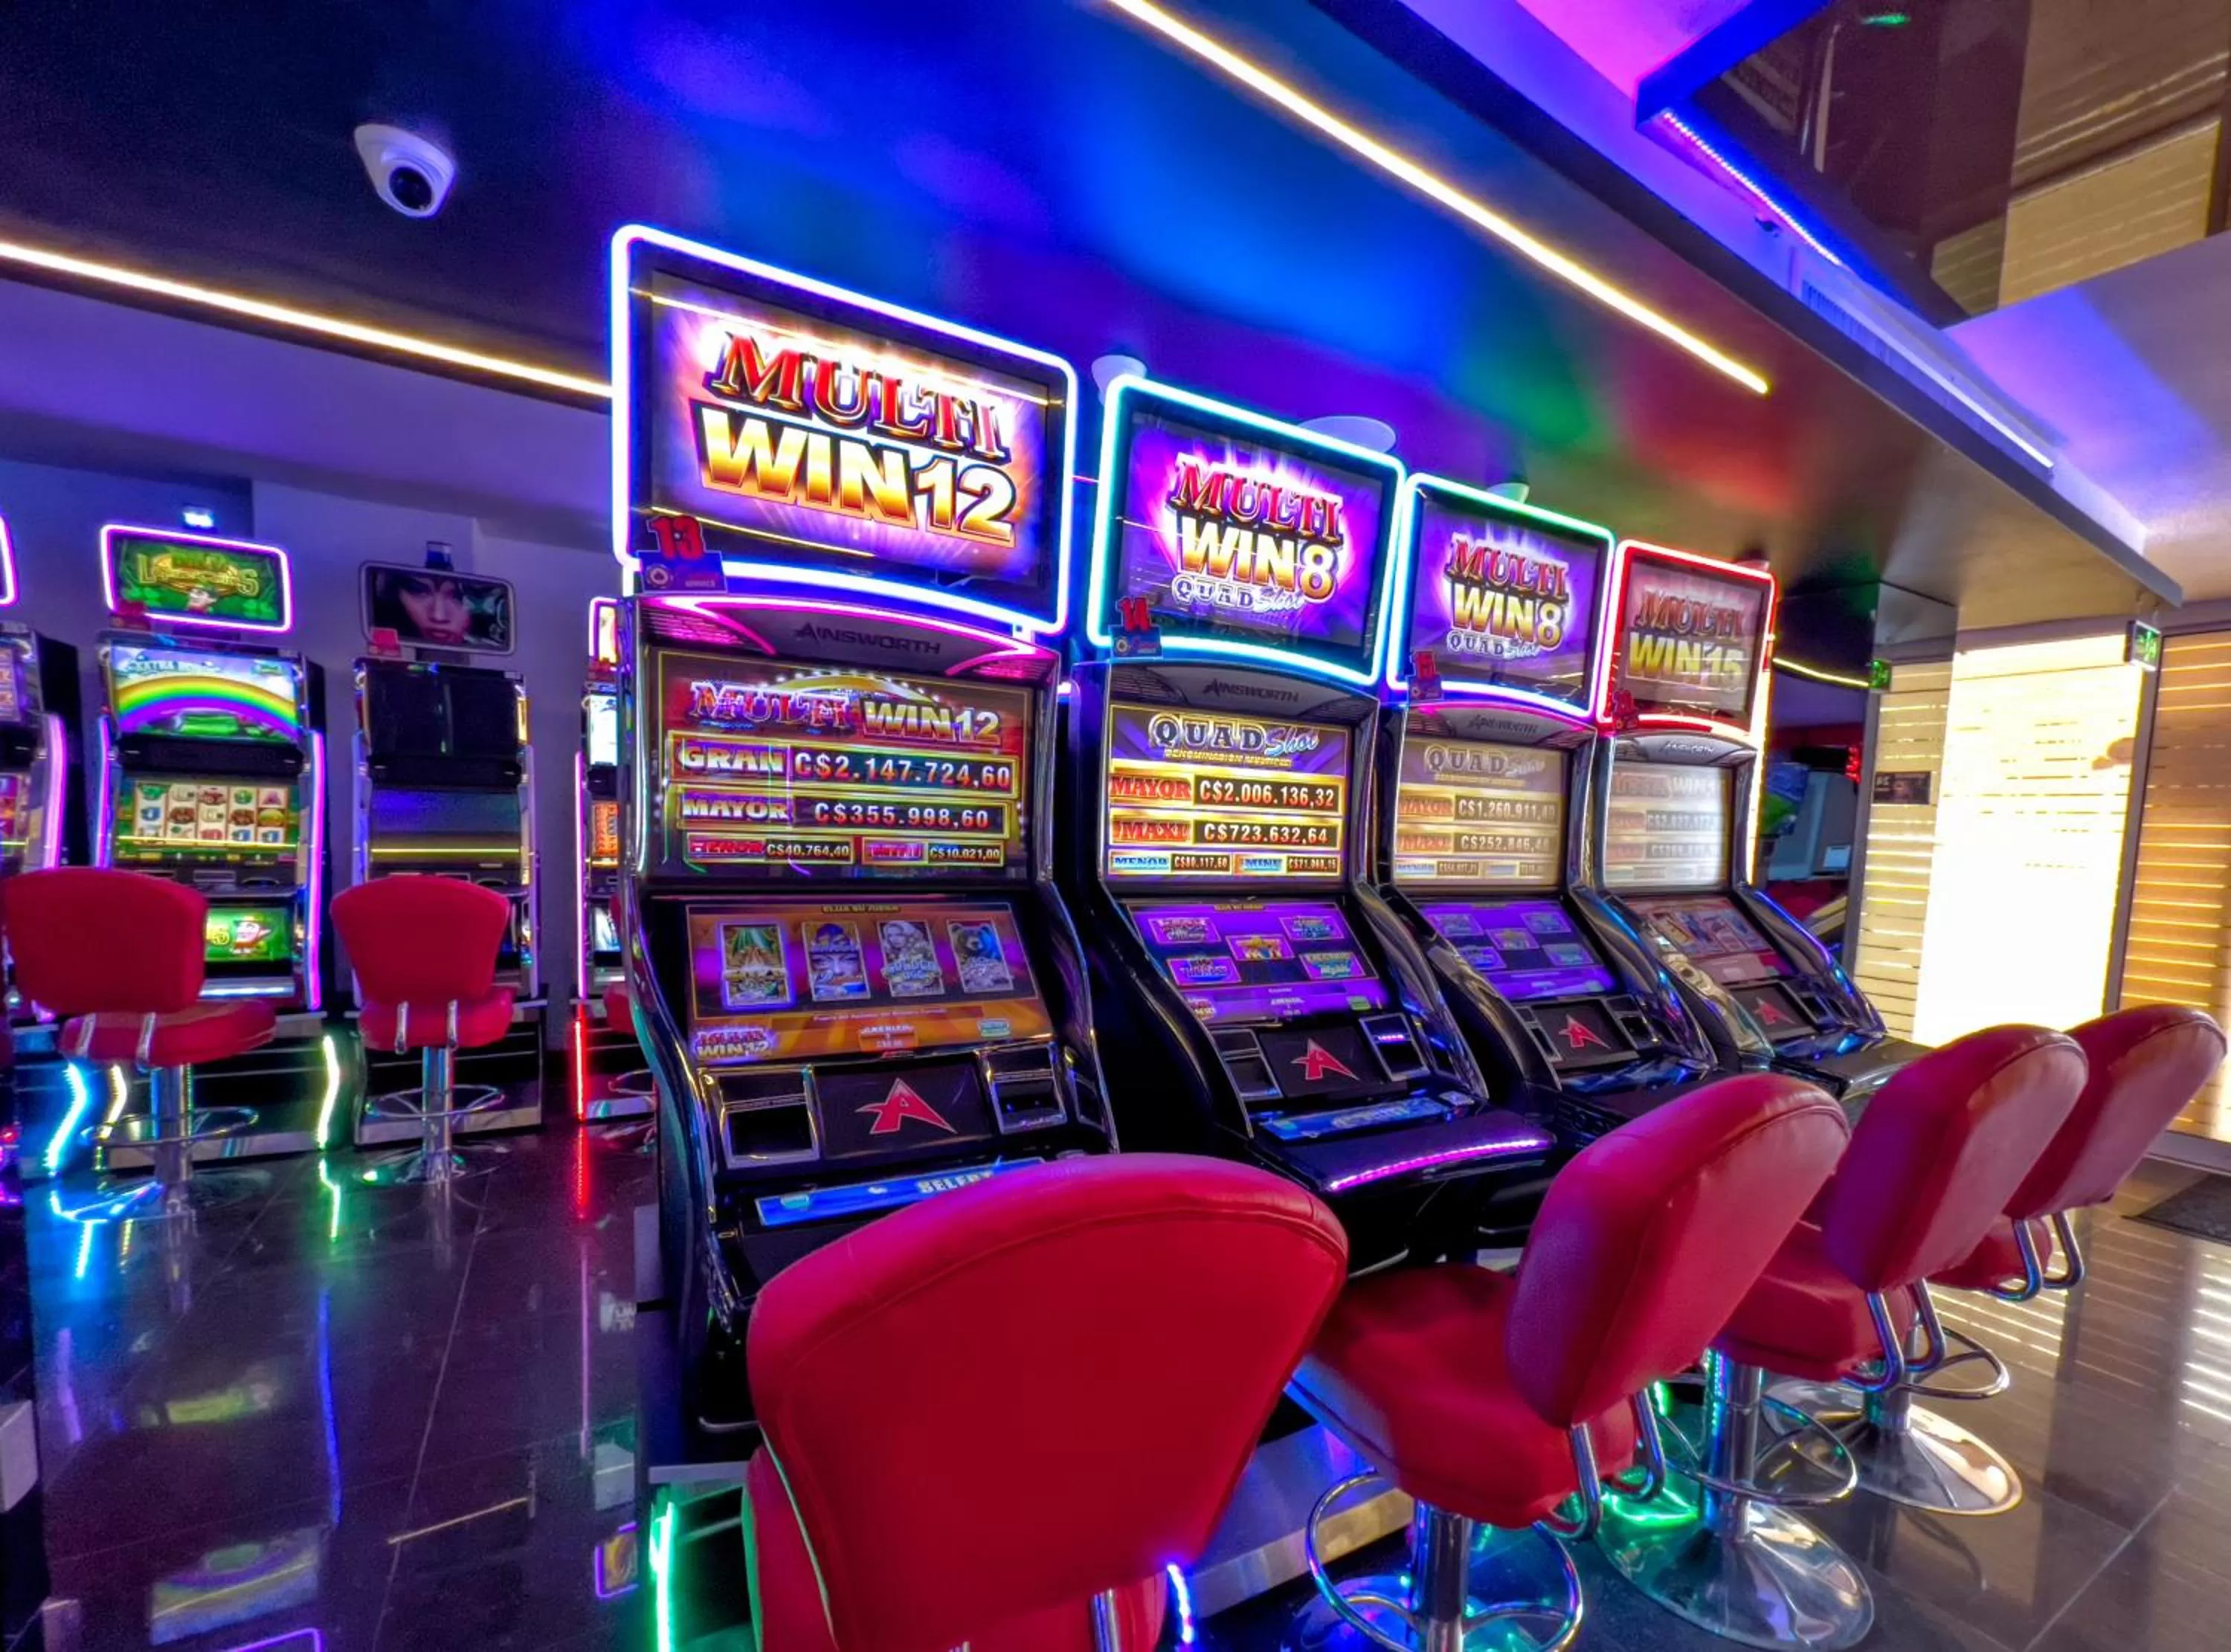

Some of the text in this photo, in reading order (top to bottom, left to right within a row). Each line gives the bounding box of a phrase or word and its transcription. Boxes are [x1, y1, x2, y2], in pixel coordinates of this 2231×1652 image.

[704, 330, 1013, 462] MULTI
[1169, 461, 1344, 543] MULTI
[1446, 538, 1568, 601] MULTI
[1174, 575, 1255, 610] QUAD
[1635, 592, 1745, 642] MULTI
[793, 622, 941, 654] AINSWORTH
[1448, 632, 1504, 656] QUAD
[689, 681, 851, 729] MULTI
[1203, 678, 1300, 702] AINSWORTH
[1148, 712, 1266, 751] QUAD
[677, 743, 1010, 789] GRAN C$2.147.724,60
[1425, 744, 1508, 773] QUAD
[1109, 775, 1191, 799] MAYOR
[683, 798, 989, 829] MAYOR C$355.998,60
